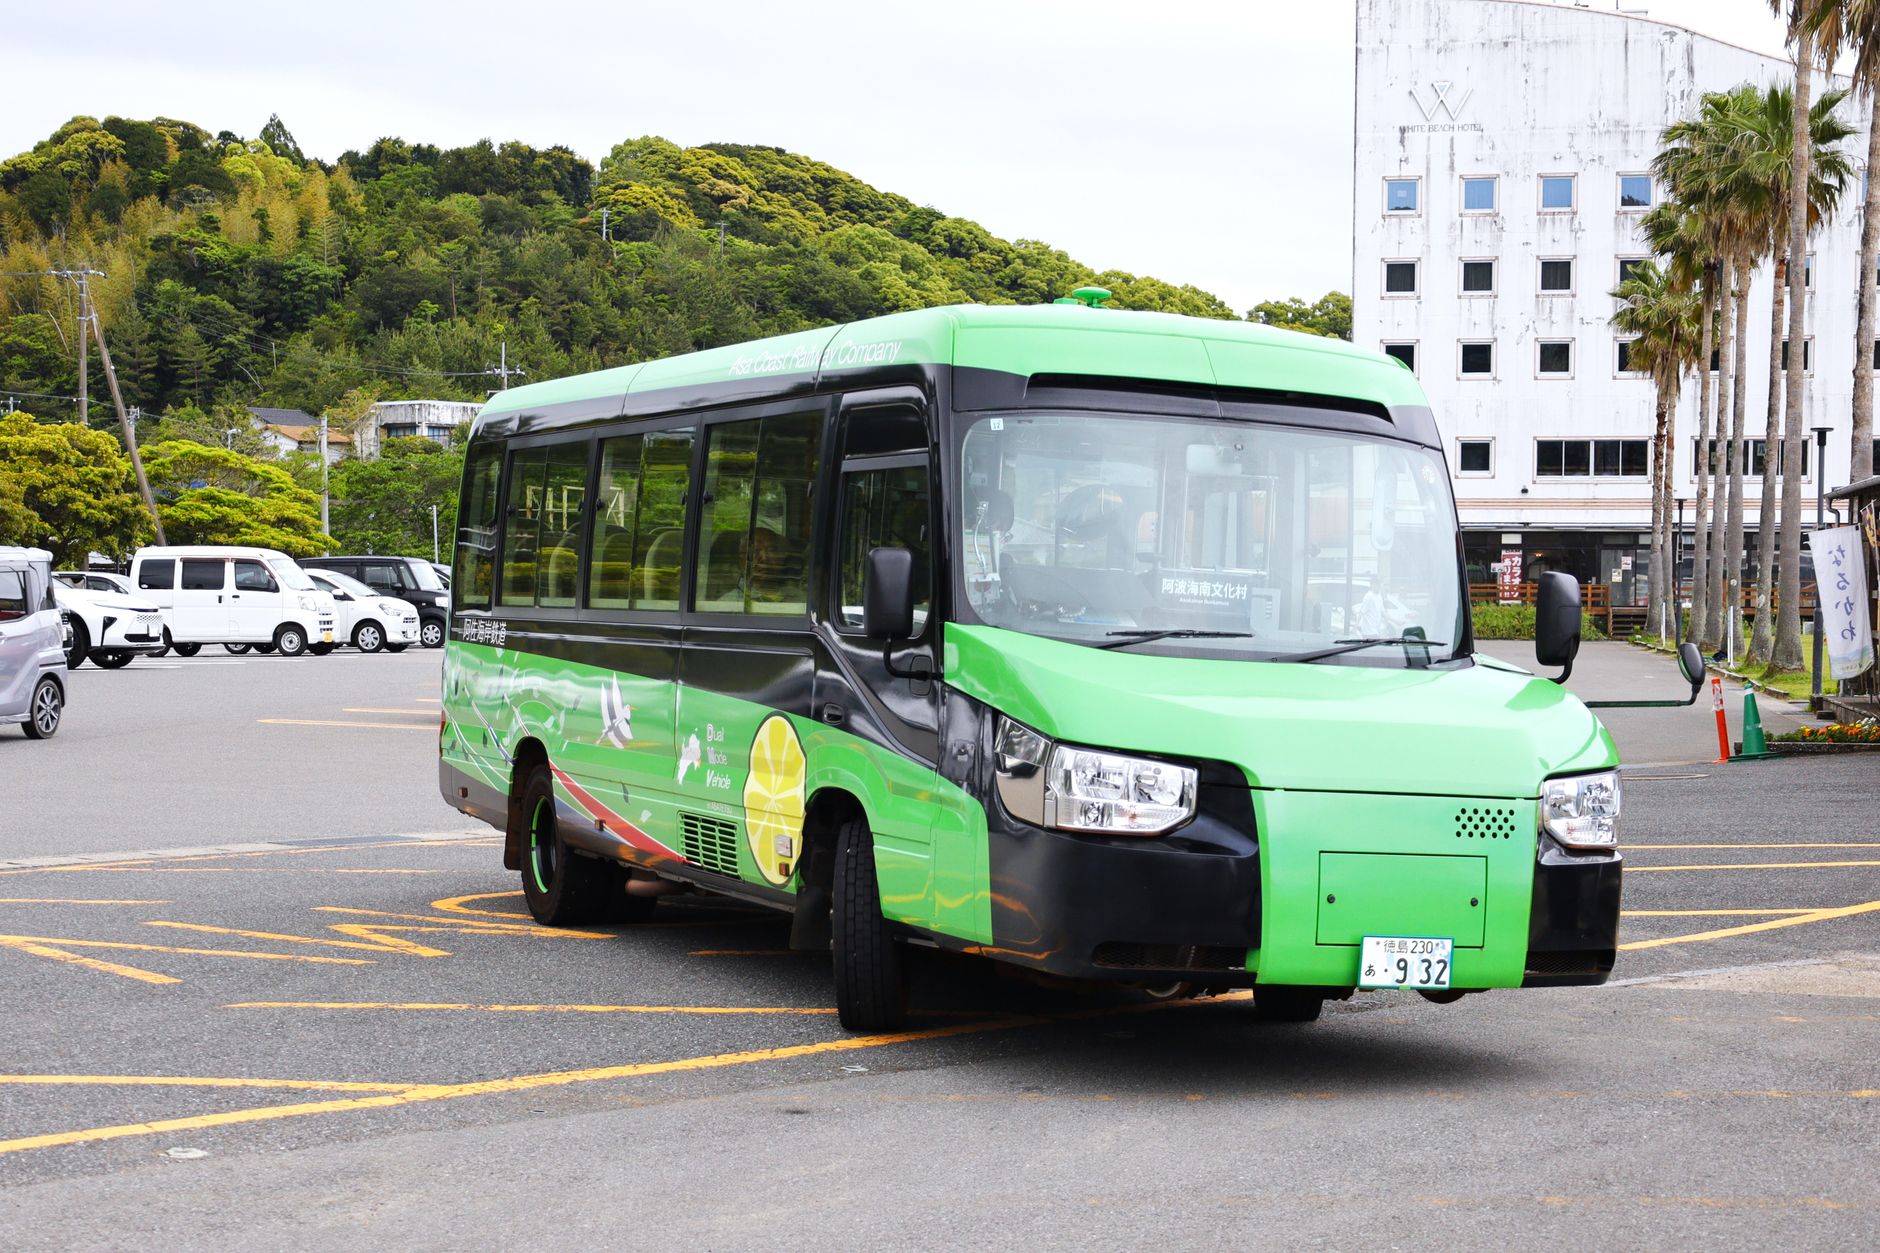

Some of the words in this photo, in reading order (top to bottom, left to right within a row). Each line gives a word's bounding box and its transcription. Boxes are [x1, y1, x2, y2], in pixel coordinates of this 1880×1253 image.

[1428, 123, 1455, 133] BEACH
[1457, 123, 1482, 132] HOTEL
[729, 357, 751, 376] Asa
[754, 351, 787, 374] Coast
[790, 345, 836, 370] Railway
[838, 340, 903, 365] Company
[1161, 577, 1248, 600] 阿波海南文化村
[462, 618, 507, 646] 阿佐海岸鉄道
[706, 723, 725, 742] Dual
[706, 746, 728, 766] Mode
[706, 769, 731, 790] Vehicle
